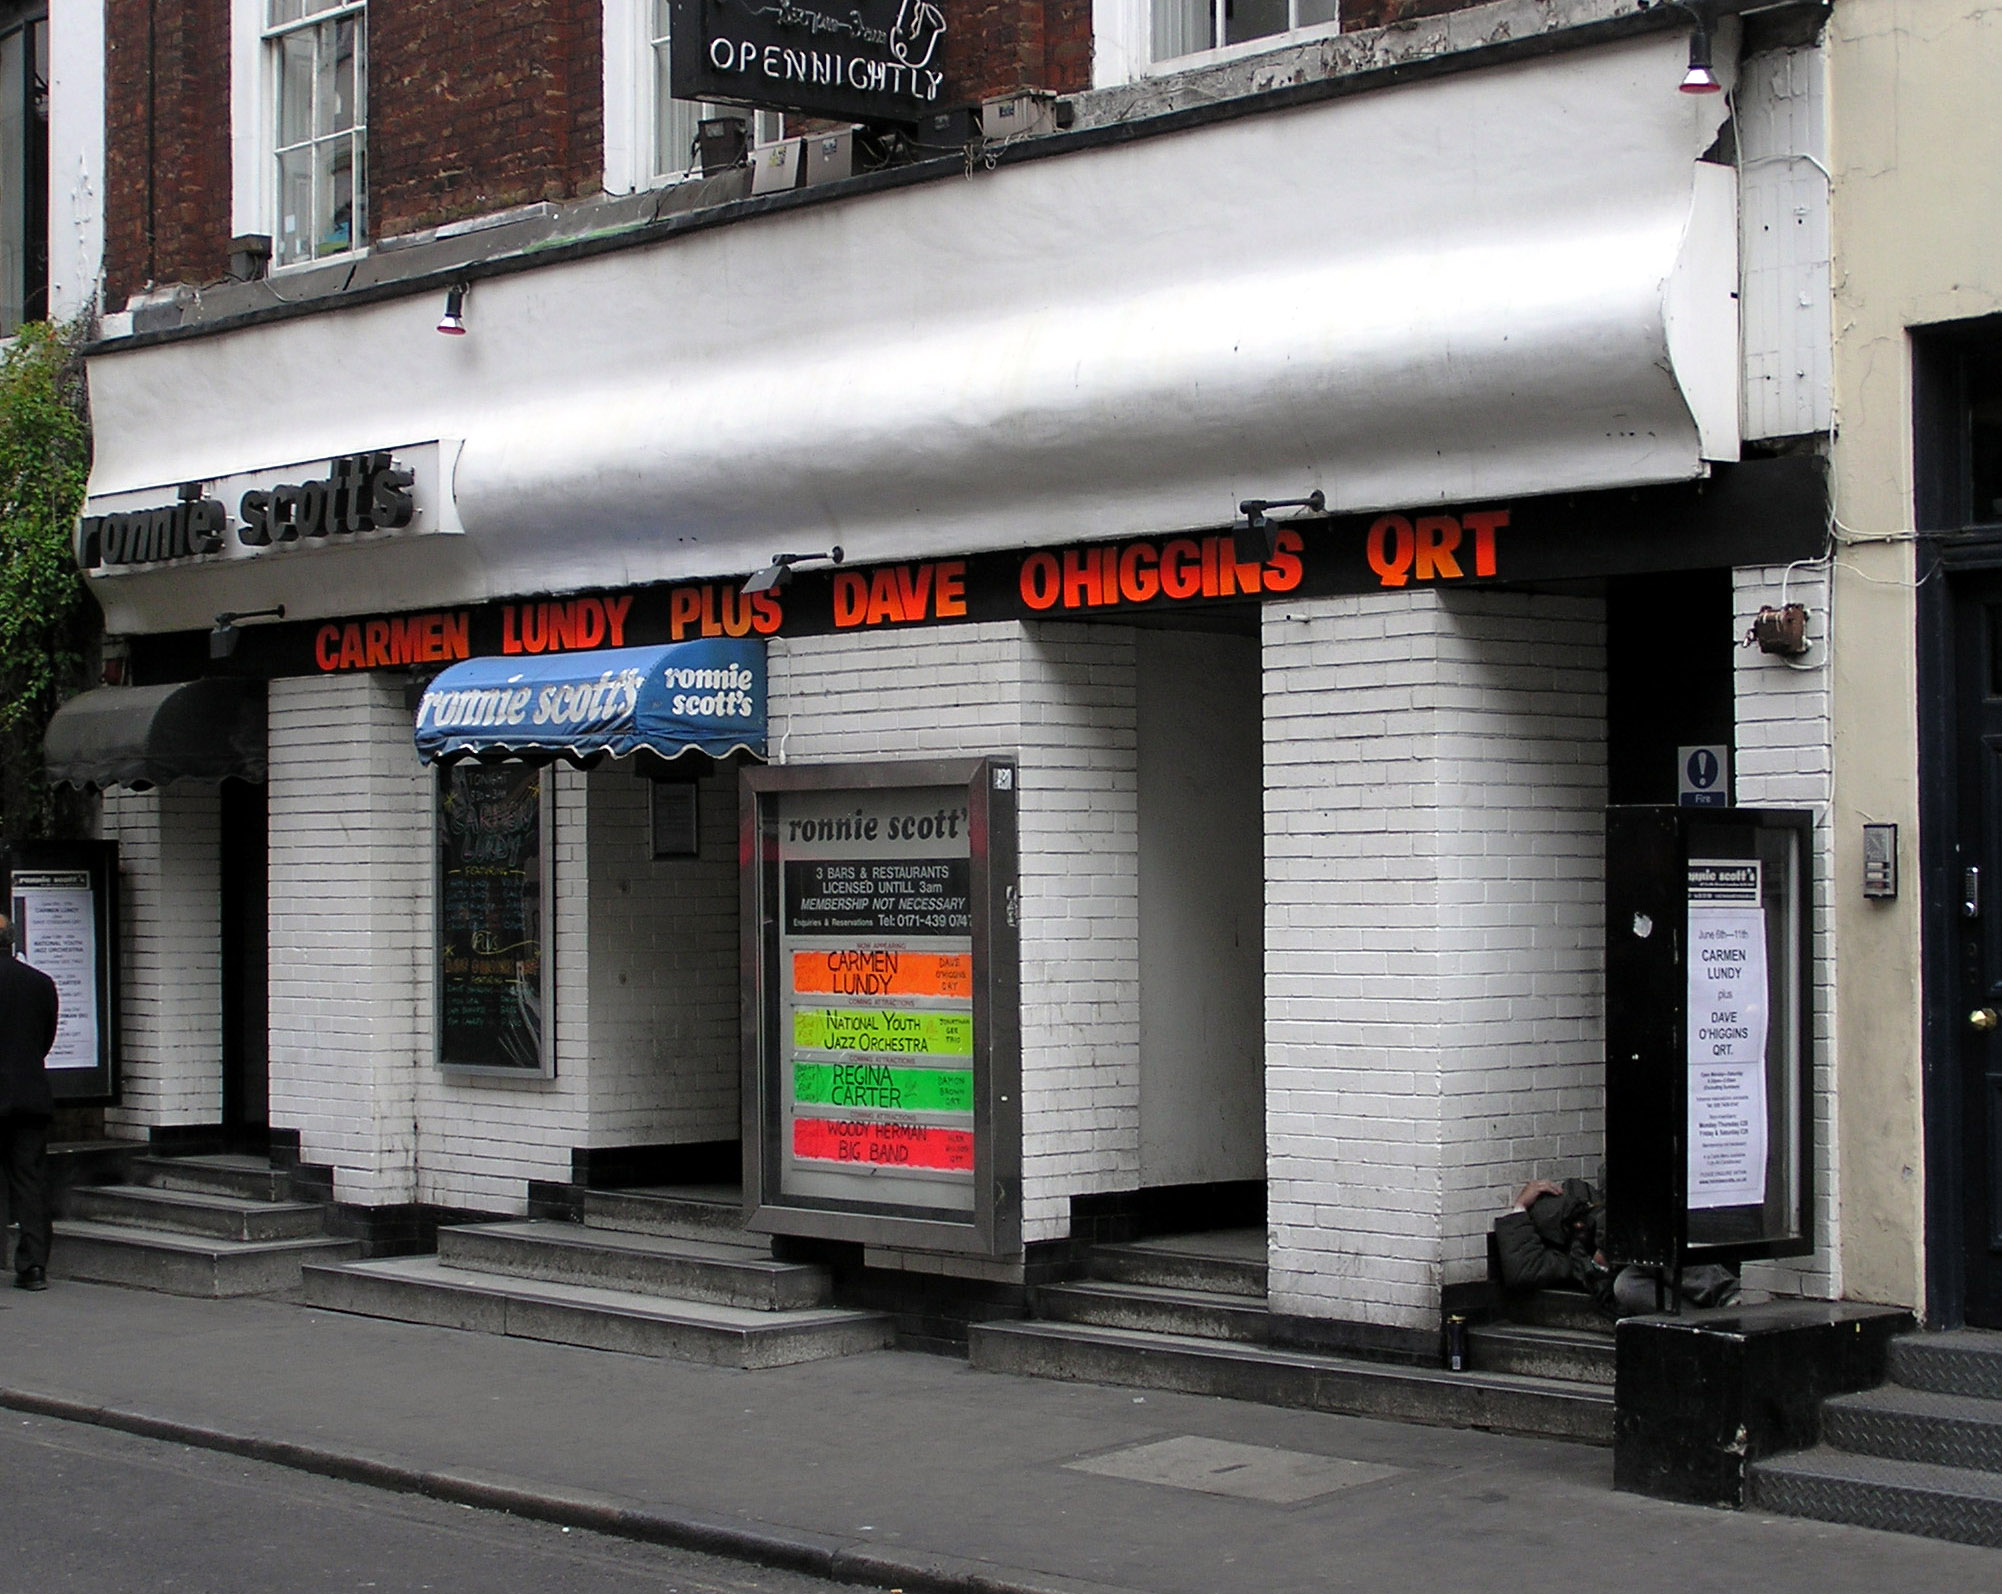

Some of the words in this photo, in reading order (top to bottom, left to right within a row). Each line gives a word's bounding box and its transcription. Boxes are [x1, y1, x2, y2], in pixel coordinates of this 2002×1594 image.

[79, 482, 228, 568] ronnie
[238, 451, 415, 546] scott's
[315, 612, 470, 671] CARMEN
[503, 595, 634, 655] LUNDY
[671, 584, 784, 641] PLUS
[833, 561, 968, 628] DAVE
[1019, 529, 1305, 611] OHIGGINS
[1366, 509, 1511, 587] QRT
[664, 662, 753, 691] ronnie
[416, 674, 532, 728] ronnie
[533, 667, 645, 726] scott's
[672, 690, 753, 717] scott's
[1695, 793, 1712, 803] Fire
[788, 808, 879, 842] ronnie
[887, 807, 971, 841] scott'
[815, 866, 823, 880] 3
[827, 866, 855, 880] BARS
[859, 866, 868, 879] &
[872, 865, 950, 879] RESTAURANTS
[822, 881, 874, 894] LICENSED
[878, 881, 915, 894] UNTILL
[919, 881, 943, 894] 3am
[800, 897, 870, 911] MEMBERSHIP
[872, 897, 896, 911] NOT
[898, 897, 967, 911] NECESSARY
[832, 917, 874, 927] Reservations
[878, 914, 896, 927] Tel:
[897, 914, 946, 928] 0171-439
[827, 950, 898, 974] CARMEN
[1701, 949, 1747, 961] CARMEN
[1707, 967, 1742, 980] LUNDY
[833, 974, 893, 996] LUNDY
[1717, 988, 1733, 1001] plus
[826, 1009, 879, 1031] NATIONAL
[882, 1010, 921, 1032] YOUTH
[1711, 1011, 1738, 1023] DAVE
[824, 1032, 856, 1050] JAZZ
[858, 1032, 929, 1053] ORCHESTRA
[1698, 1027, 1749, 1040] O'HIGGINS
[833, 1064, 893, 1086] REGINA
[831, 1086, 902, 1109] CARTER
[827, 1121, 871, 1138] WOODY
[875, 1123, 928, 1141] HERMAN
[838, 1141, 861, 1161] BIG
[869, 1143, 909, 1163] BAND
